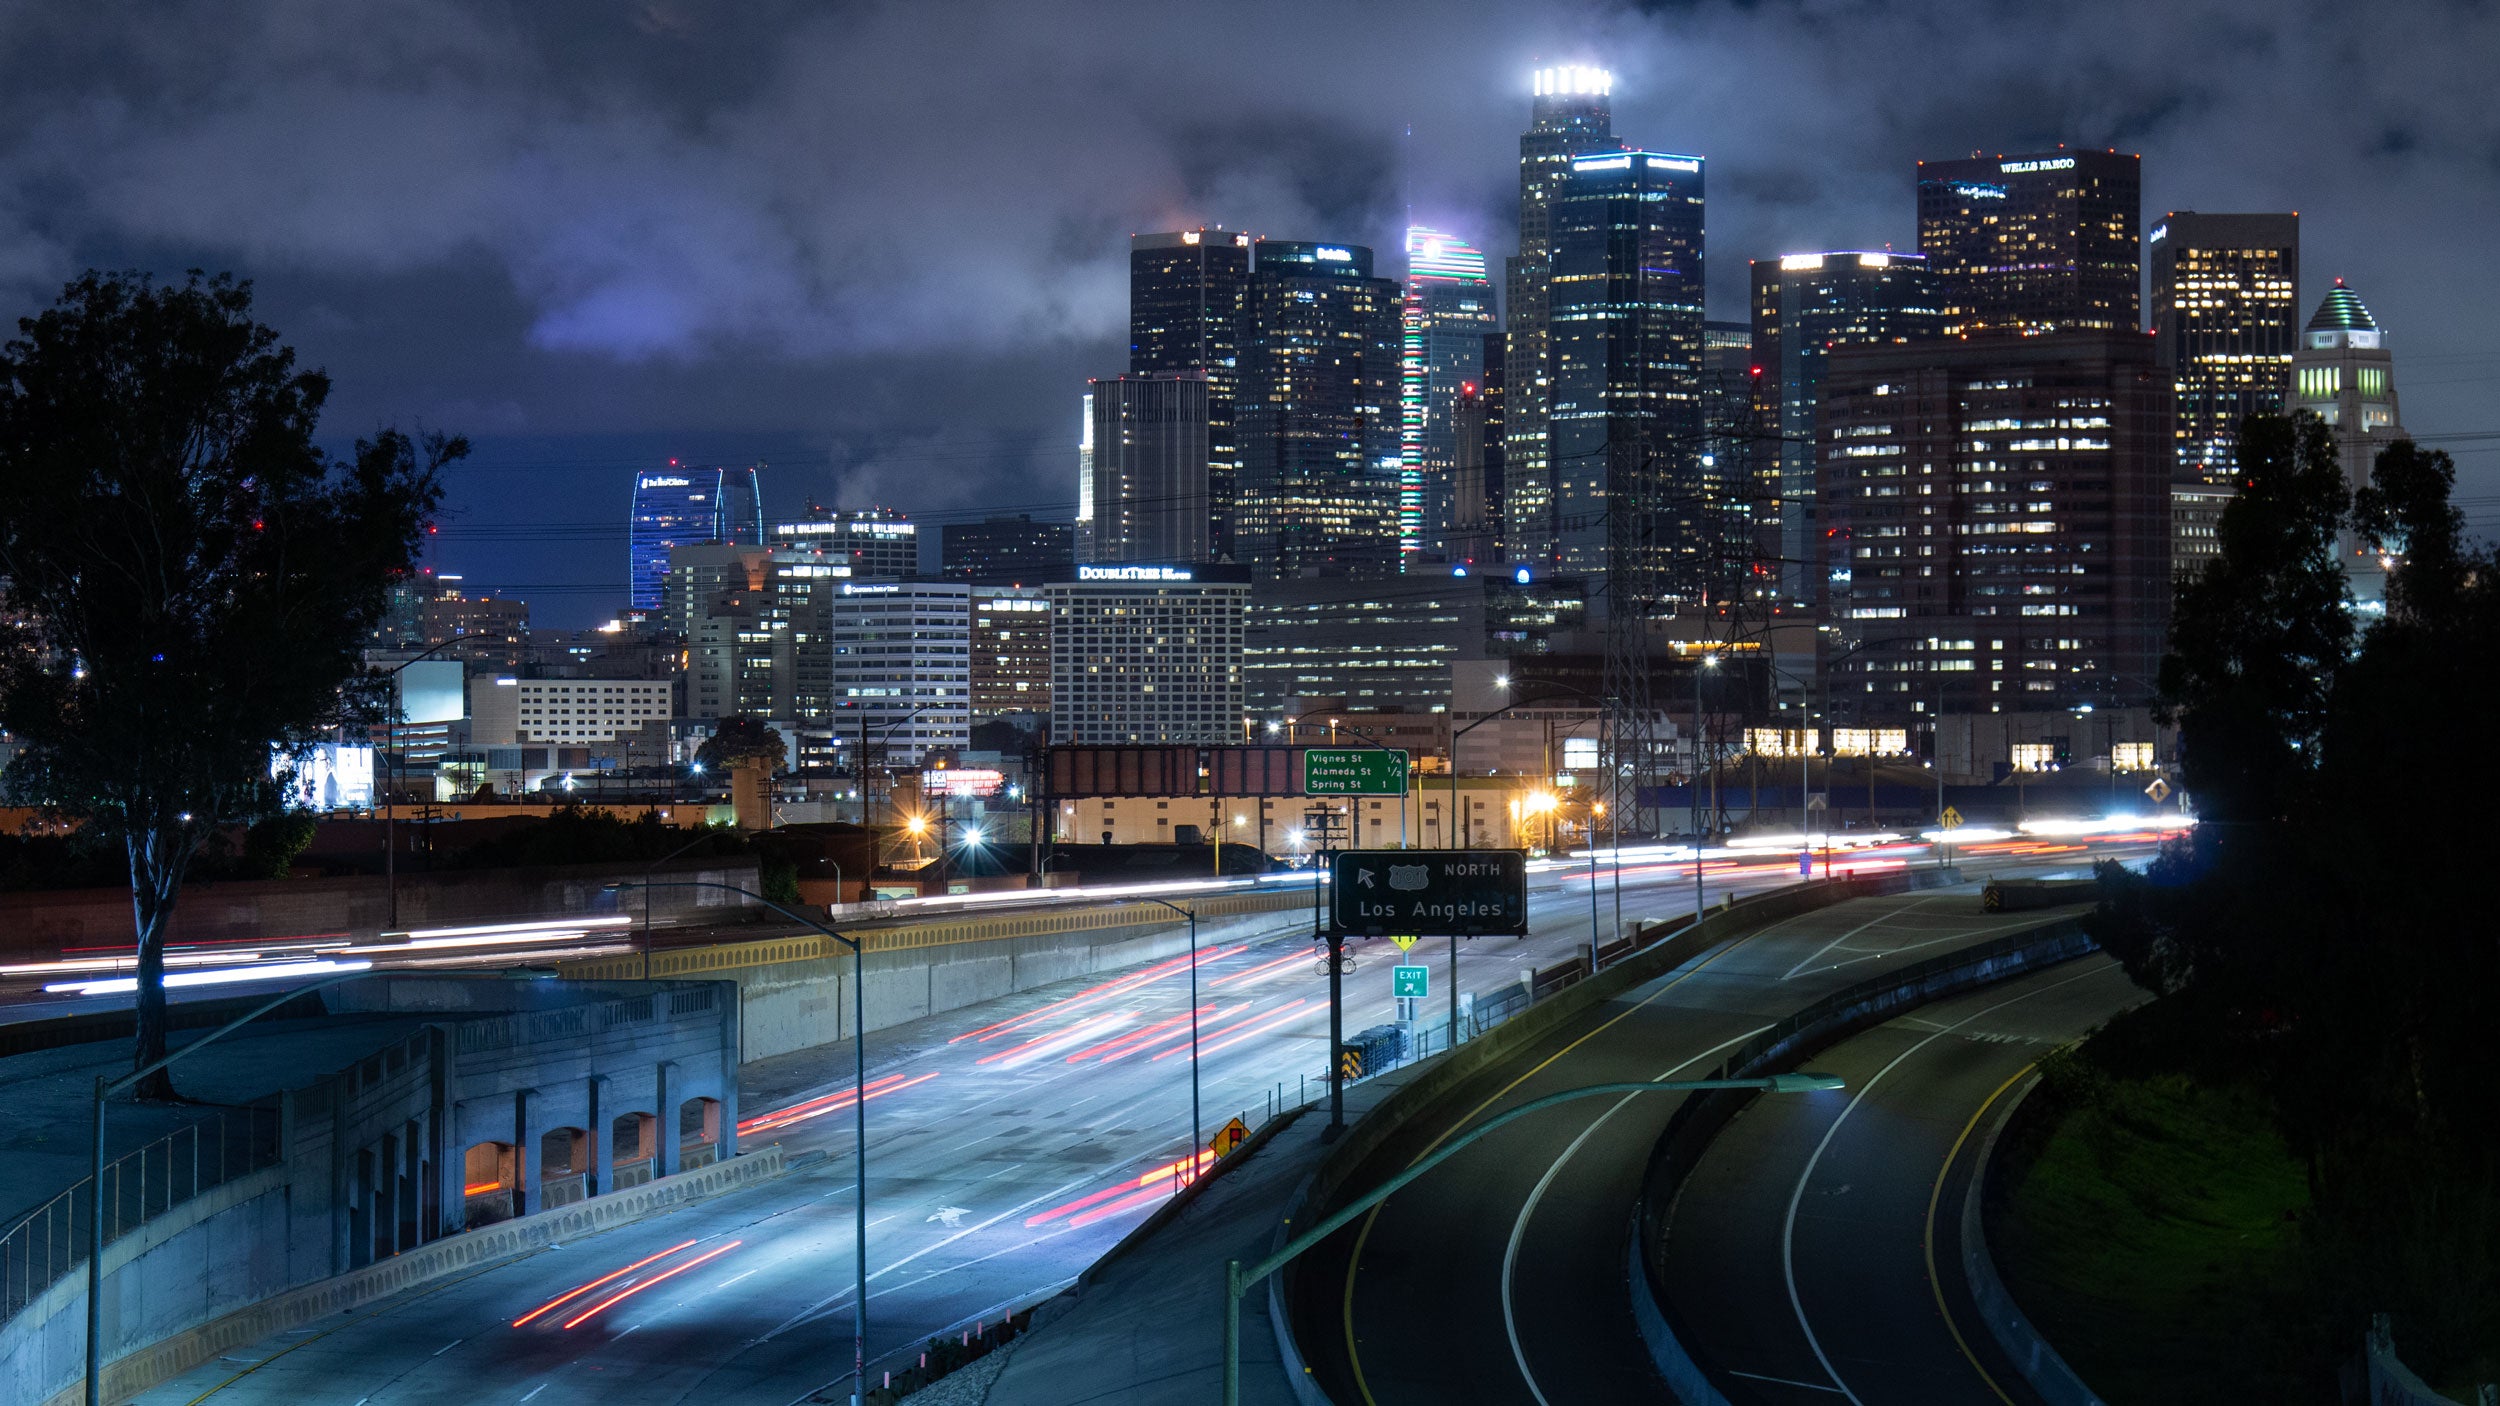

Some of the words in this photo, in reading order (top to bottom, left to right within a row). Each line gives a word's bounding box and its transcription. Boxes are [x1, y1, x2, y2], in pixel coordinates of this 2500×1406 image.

[2000, 161, 2038, 173] WELLS
[2039, 158, 2075, 171] FARGO
[778, 525, 795, 534] ONE
[797, 523, 836, 534] WILSHIRE
[851, 523, 870, 533] ONE
[872, 523, 914, 534] WILSHIRE
[1312, 754, 1346, 764] Vignes
[1351, 754, 1362, 763] St
[1312, 767, 1355, 776] Alameda
[1360, 767, 1371, 776] St
[1312, 780, 1345, 790] Spring
[1350, 780, 1361, 788] St
[1382, 780, 1386, 788] 1
[1444, 863, 1500, 876] NORTH
[1360, 901, 1396, 917] Los
[1412, 900, 1502, 923] Angeles
[1399, 971, 1422, 980] EXIT
